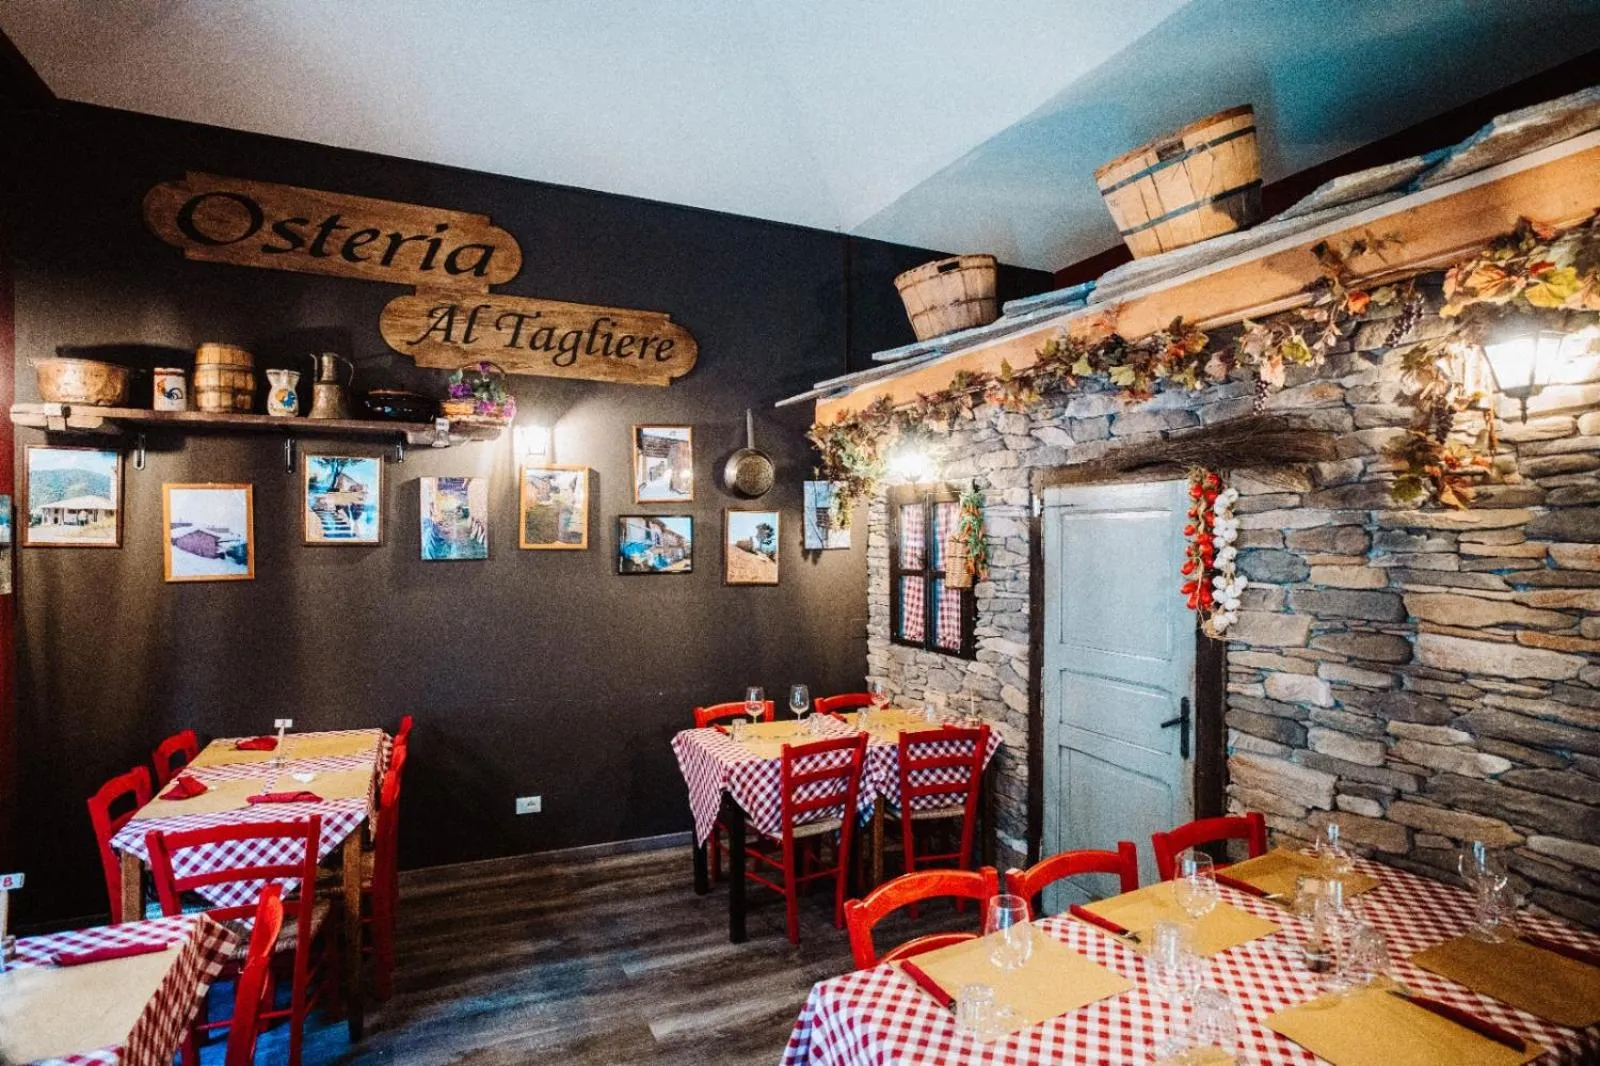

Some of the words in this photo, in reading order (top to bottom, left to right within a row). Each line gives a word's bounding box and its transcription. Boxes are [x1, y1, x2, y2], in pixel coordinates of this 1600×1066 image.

[177, 191, 496, 278] Osteria
[407, 304, 491, 345] Al
[495, 312, 675, 367] Tagliere
